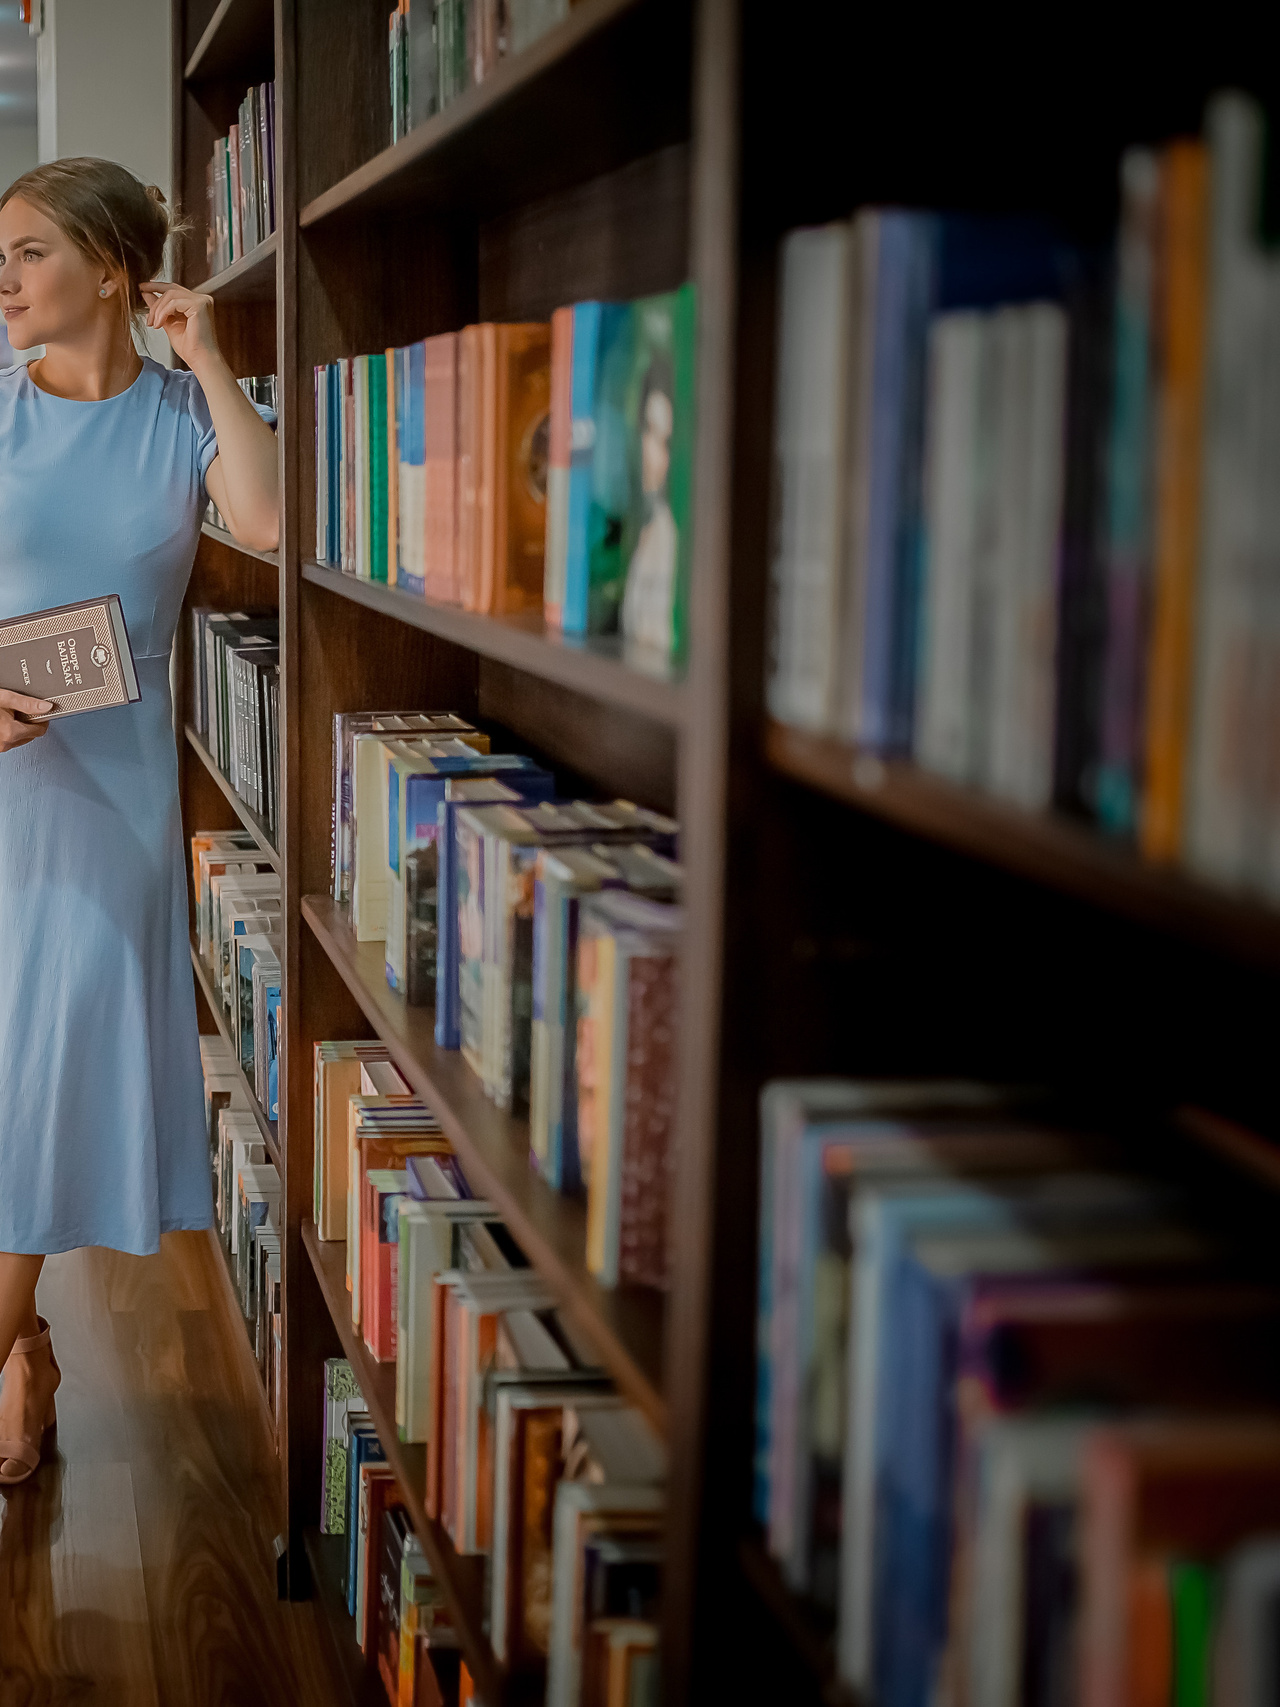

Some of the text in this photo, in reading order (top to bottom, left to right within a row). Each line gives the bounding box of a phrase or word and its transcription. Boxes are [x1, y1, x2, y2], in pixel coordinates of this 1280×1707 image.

[57, 640, 74, 687] БАЛЬЗАК
[67, 638, 83, 685] Оноре де
